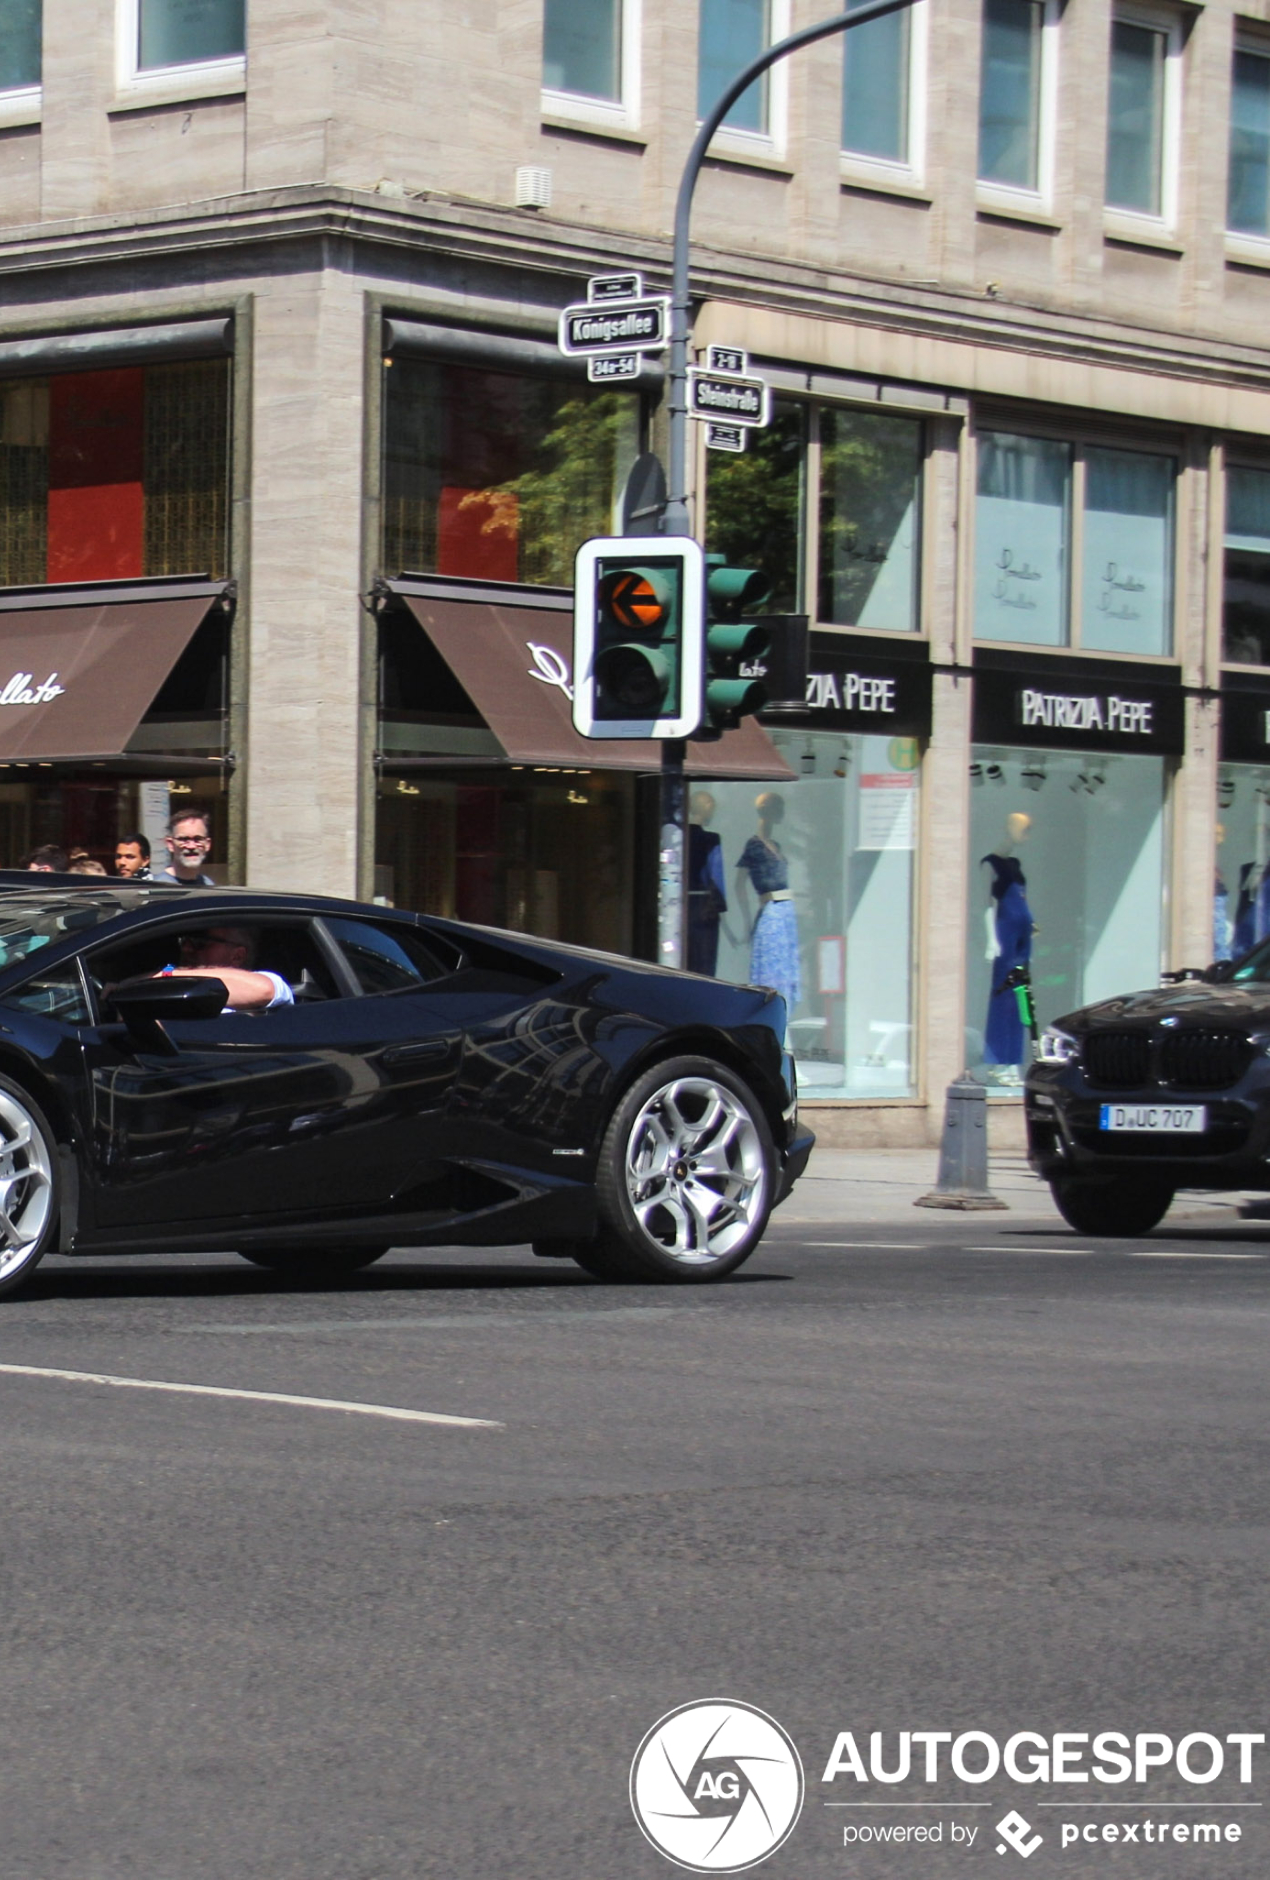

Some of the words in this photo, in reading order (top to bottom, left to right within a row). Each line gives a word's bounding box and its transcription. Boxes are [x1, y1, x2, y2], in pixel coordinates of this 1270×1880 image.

[572, 313, 652, 342] Königsallee
[844, 673, 895, 713] PEPE
[1022, 690, 1103, 730] PATRIZIA
[1107, 696, 1152, 734] PEPE
[1116, 1109, 1125, 1126] D
